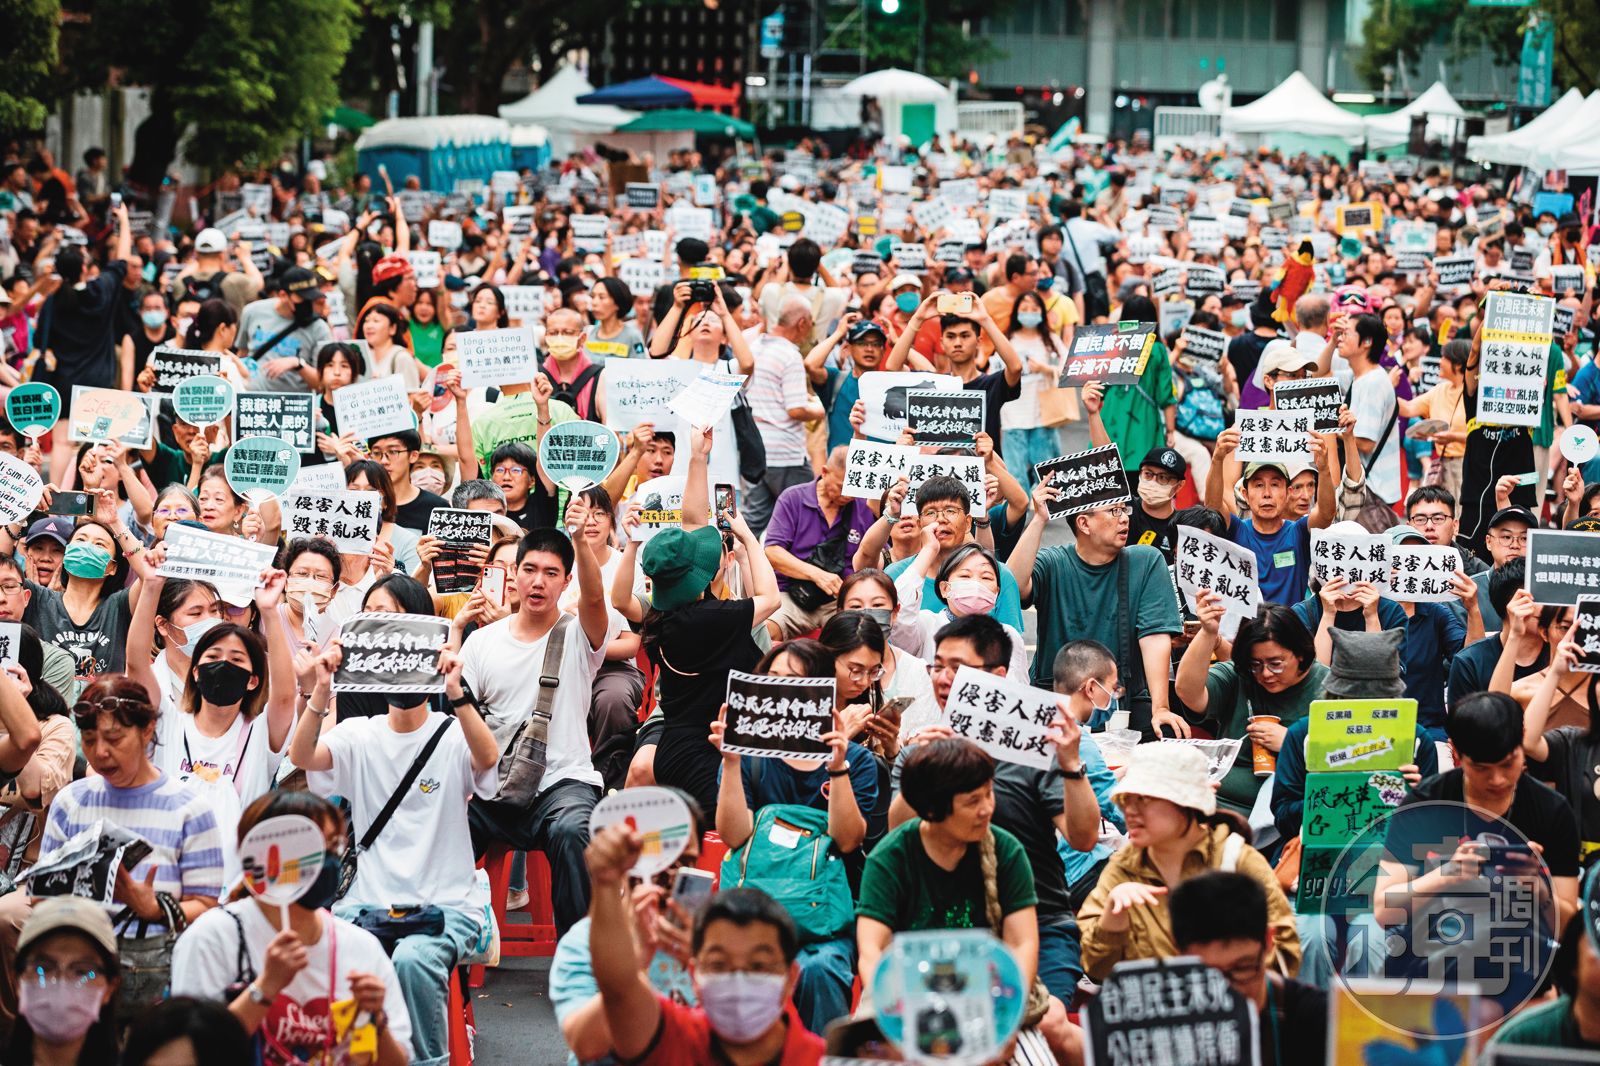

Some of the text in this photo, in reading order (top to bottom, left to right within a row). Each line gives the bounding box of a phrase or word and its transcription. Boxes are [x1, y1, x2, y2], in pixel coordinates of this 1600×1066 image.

[1073, 333, 1147, 354] 國民黨不倒
[1486, 343, 1543, 360] 侵害人權
[1067, 356, 1140, 377] 台灣不會好
[1485, 359, 1543, 378] 毀憲亂政
[240, 397, 282, 414] 我藐視
[1240, 417, 1309, 433] 侵害人權
[281, 429, 309, 446] 國會
[549, 434, 594, 448] 我藐視
[1239, 436, 1311, 454] 毀憲亂政
[234, 448, 277, 463] 我藐視
[846, 469, 893, 491] 毀憲亂
[294, 495, 373, 519] 侵害人權
[291, 514, 372, 542] 毀憲亂政
[1182, 536, 1253, 580] 侵害人權
[1314, 540, 1387, 562] 侵害人權
[1180, 560, 1251, 606] 毀憲亂政
[1535, 571, 1600, 588] 但明明是臺
[958, 682, 1057, 727] 侵害人權
[949, 710, 1049, 757] 毀憲亂政
[1101, 967, 1235, 1024] 台灣民主未死
